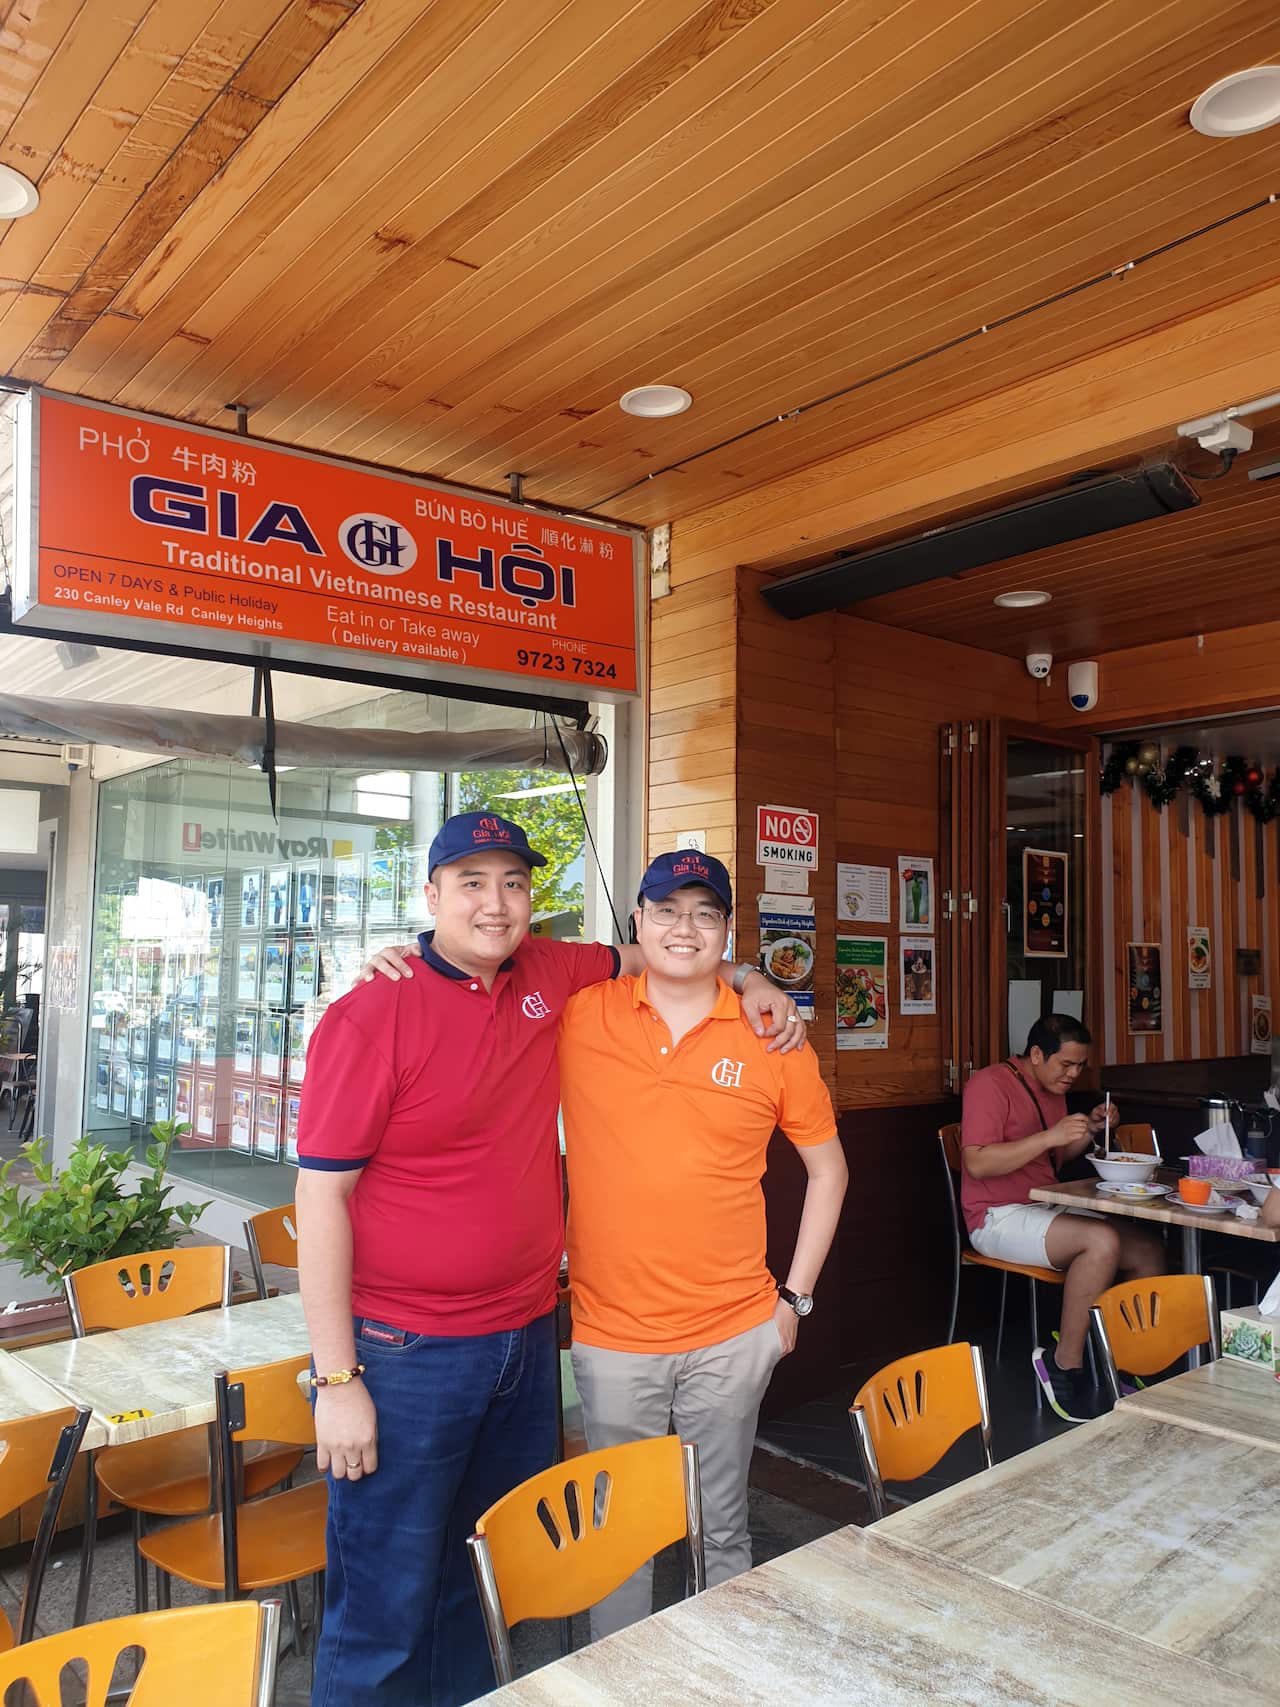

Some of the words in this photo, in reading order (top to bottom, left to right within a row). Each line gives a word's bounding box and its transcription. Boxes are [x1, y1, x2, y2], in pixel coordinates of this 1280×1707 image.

[79, 426, 150, 463] PHỞ
[171, 446, 257, 486] 牛肉粉
[415, 498, 455, 524] BÚN
[460, 508, 487, 530] BÒ
[491, 516, 529, 540] HUẾ
[130, 474, 327, 557] GIA
[436, 537, 577, 608] HỘI
[54, 564, 102, 583] OPEN
[108, 573, 117, 585] 7
[121, 574, 164, 593] DAYS
[168, 583, 179, 597] &
[184, 585, 226, 605] Public
[229, 593, 279, 615] Holiday
[161, 540, 302, 585] Traditional
[309, 566, 442, 610] Vietnamese
[449, 593, 557, 630] Restaurant
[54, 586, 80, 601] 230
[83, 591, 130, 611] Canley
[134, 598, 162, 613] Vale
[166, 603, 185, 616] Rd
[191, 607, 234, 625] Canley
[237, 614, 283, 631] Heights
[326, 605, 356, 625] Eat
[360, 610, 374, 628] in
[379, 617, 396, 631] or
[399, 617, 437, 638] Take
[441, 628, 480, 648] away
[342, 630, 399, 654] Delivery
[402, 642, 460, 660] available
[517, 649, 566, 673] 9723
[572, 657, 617, 680] 7324
[552, 639, 588, 655] PHONE
[765, 815, 791, 839] NO
[763, 846, 813, 863] SMOKING
